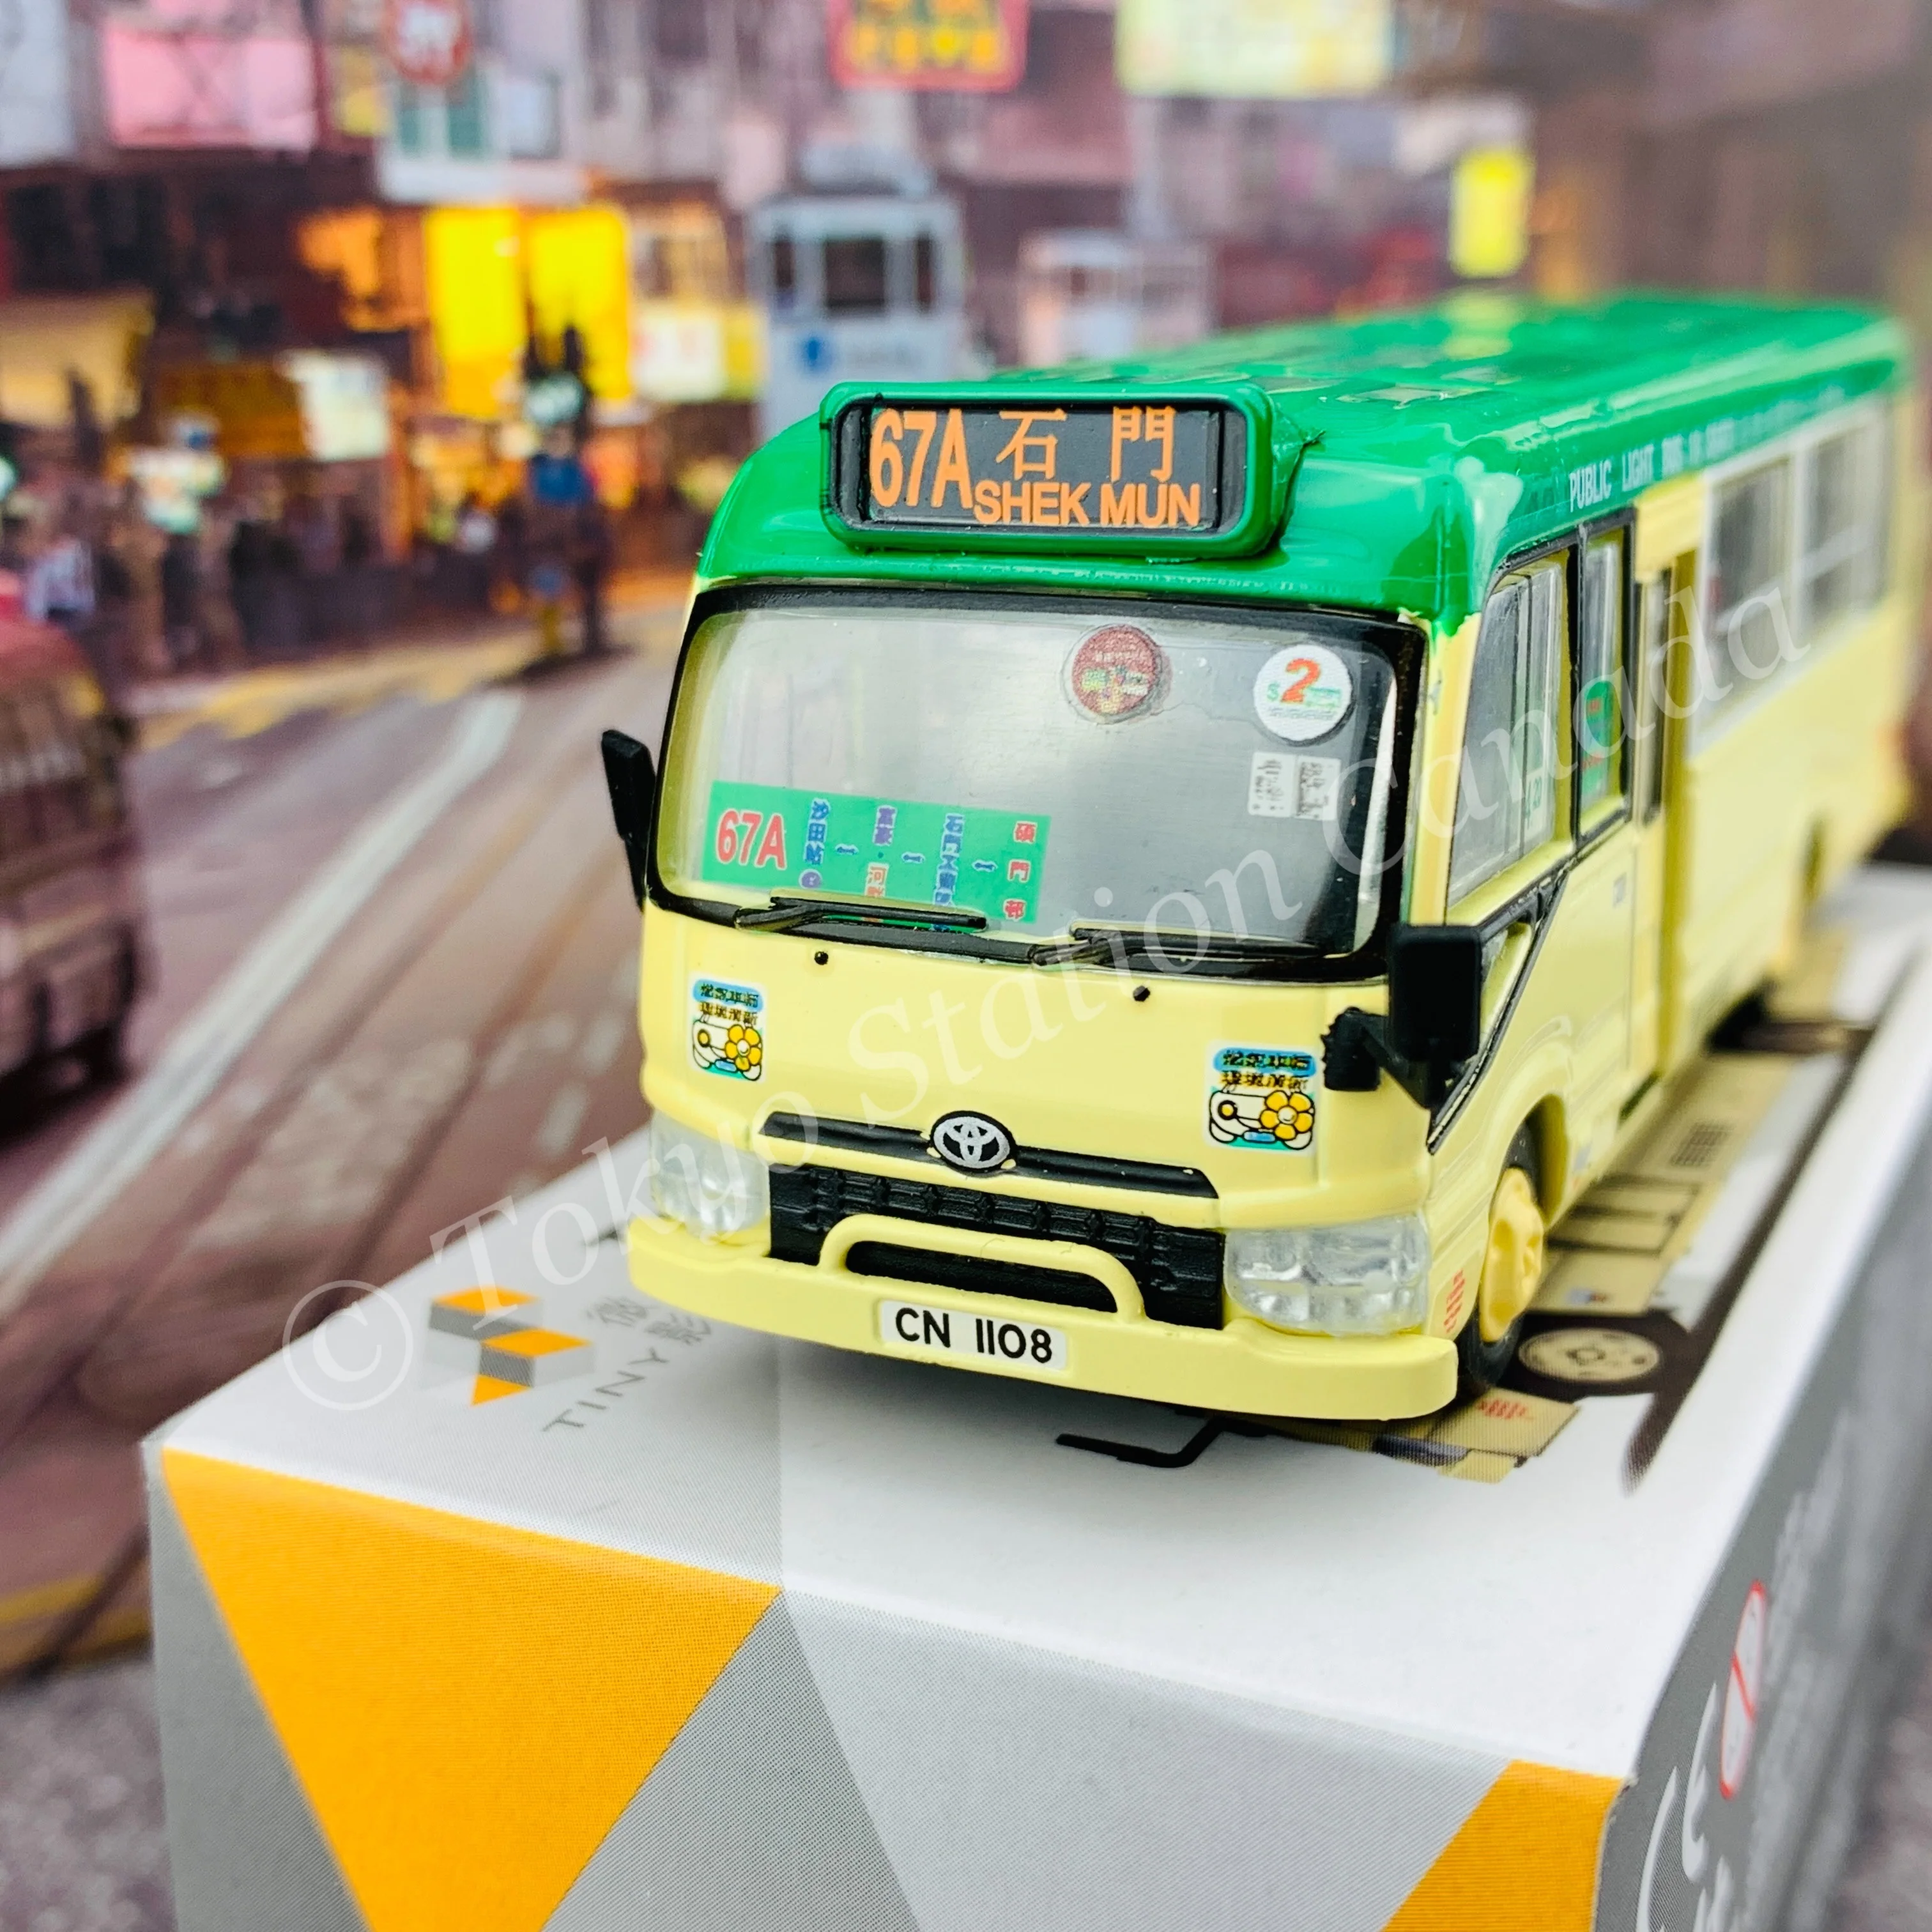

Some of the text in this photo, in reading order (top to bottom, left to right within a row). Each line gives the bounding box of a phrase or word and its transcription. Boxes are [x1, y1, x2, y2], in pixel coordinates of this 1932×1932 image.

[870, 407, 973, 509] 67A
[995, 406, 1177, 483] 石門
[1569, 459, 1612, 512] PUBLIC
[1621, 443, 1655, 491] LIGHT
[974, 482, 1201, 528] SHEK MUN
[716, 810, 786, 870] 67A
[895, 1307, 1052, 1363] CN 1108
[542, 1346, 670, 1432] TINY
